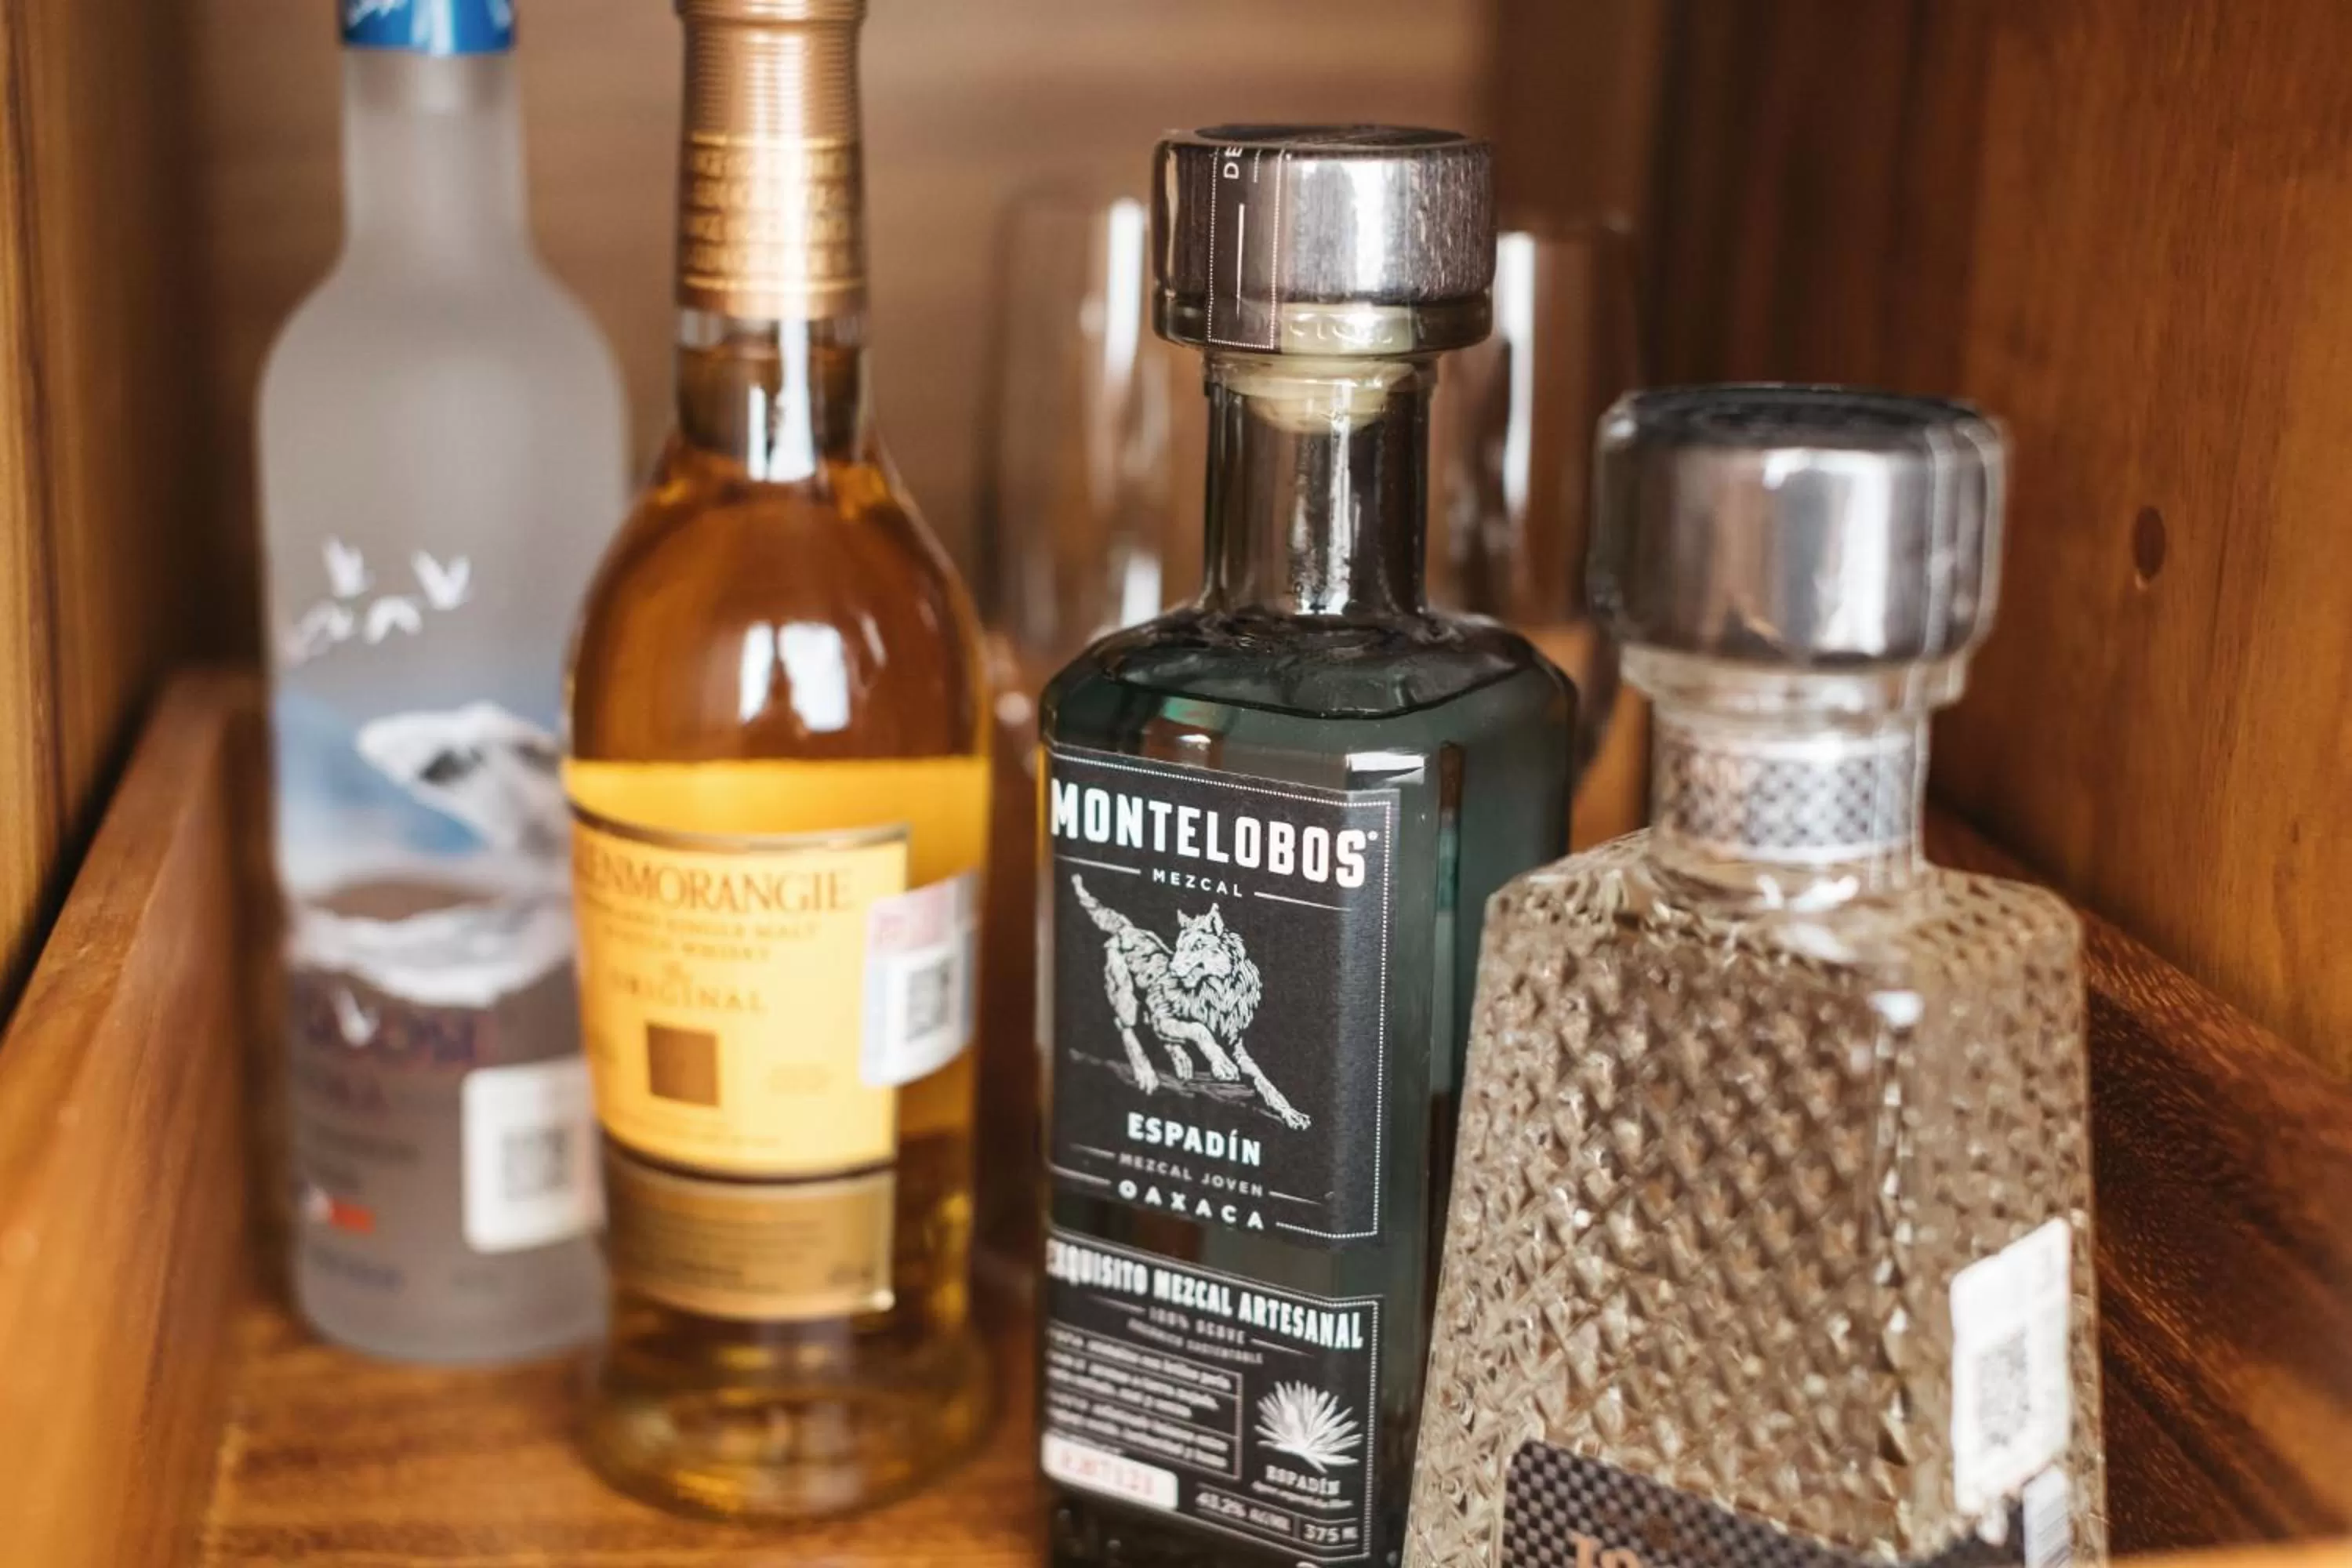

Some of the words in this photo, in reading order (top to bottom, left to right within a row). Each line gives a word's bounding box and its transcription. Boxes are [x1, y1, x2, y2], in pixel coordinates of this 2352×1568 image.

[1052, 779, 1367, 888] MONTELOBOS
[1152, 868, 1243, 898] MEZCAL
[1127, 1112, 1261, 1167] ESPADÍN
[1119, 1152, 1192, 1181] MEZCAL
[1201, 1171, 1264, 1197] JOVEN
[1118, 1179, 1265, 1230] OAXACA
[1152, 1268, 1233, 1318] MEZCAL
[1238, 1292, 1364, 1351] ARTESANAL
